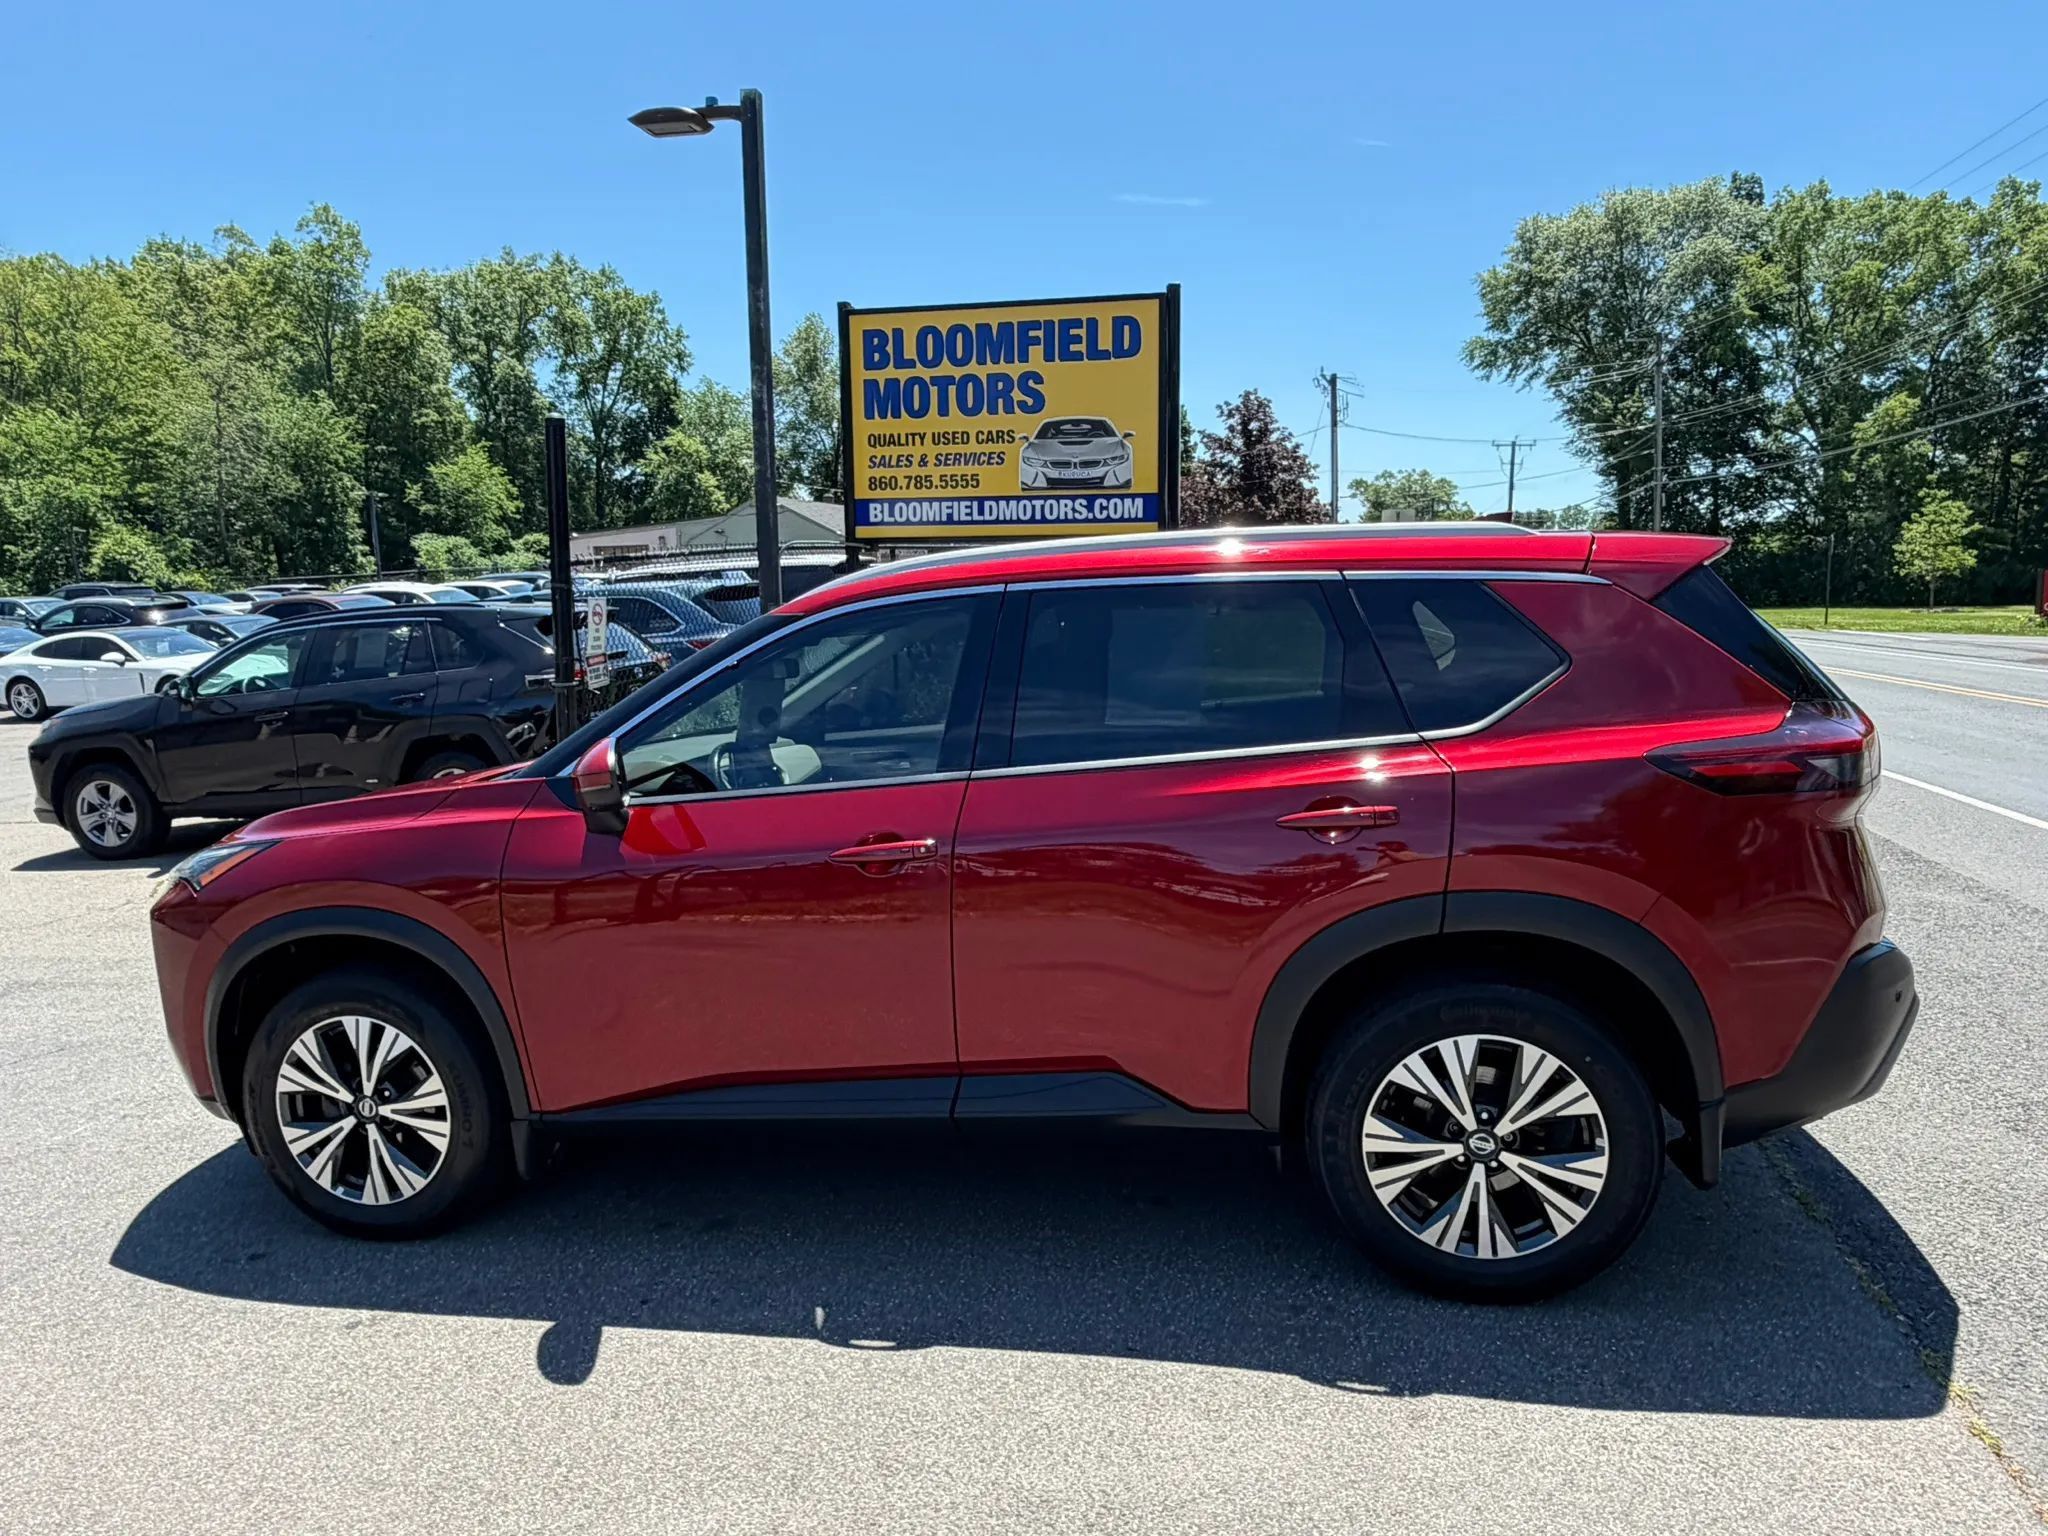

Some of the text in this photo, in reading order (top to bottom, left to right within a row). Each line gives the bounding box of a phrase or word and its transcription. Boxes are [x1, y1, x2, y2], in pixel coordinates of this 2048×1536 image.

[862, 315, 1142, 371] BLOOMFIELD
[863, 370, 1046, 420] MOTORS
[867, 429, 1016, 449] QUALITY USED CARS
[867, 451, 1006, 469] SALES & SERVICES
[867, 473, 980, 491] 860.785.5555
[868, 497, 1144, 523] BLOOMFIELDMOTORS.COM
